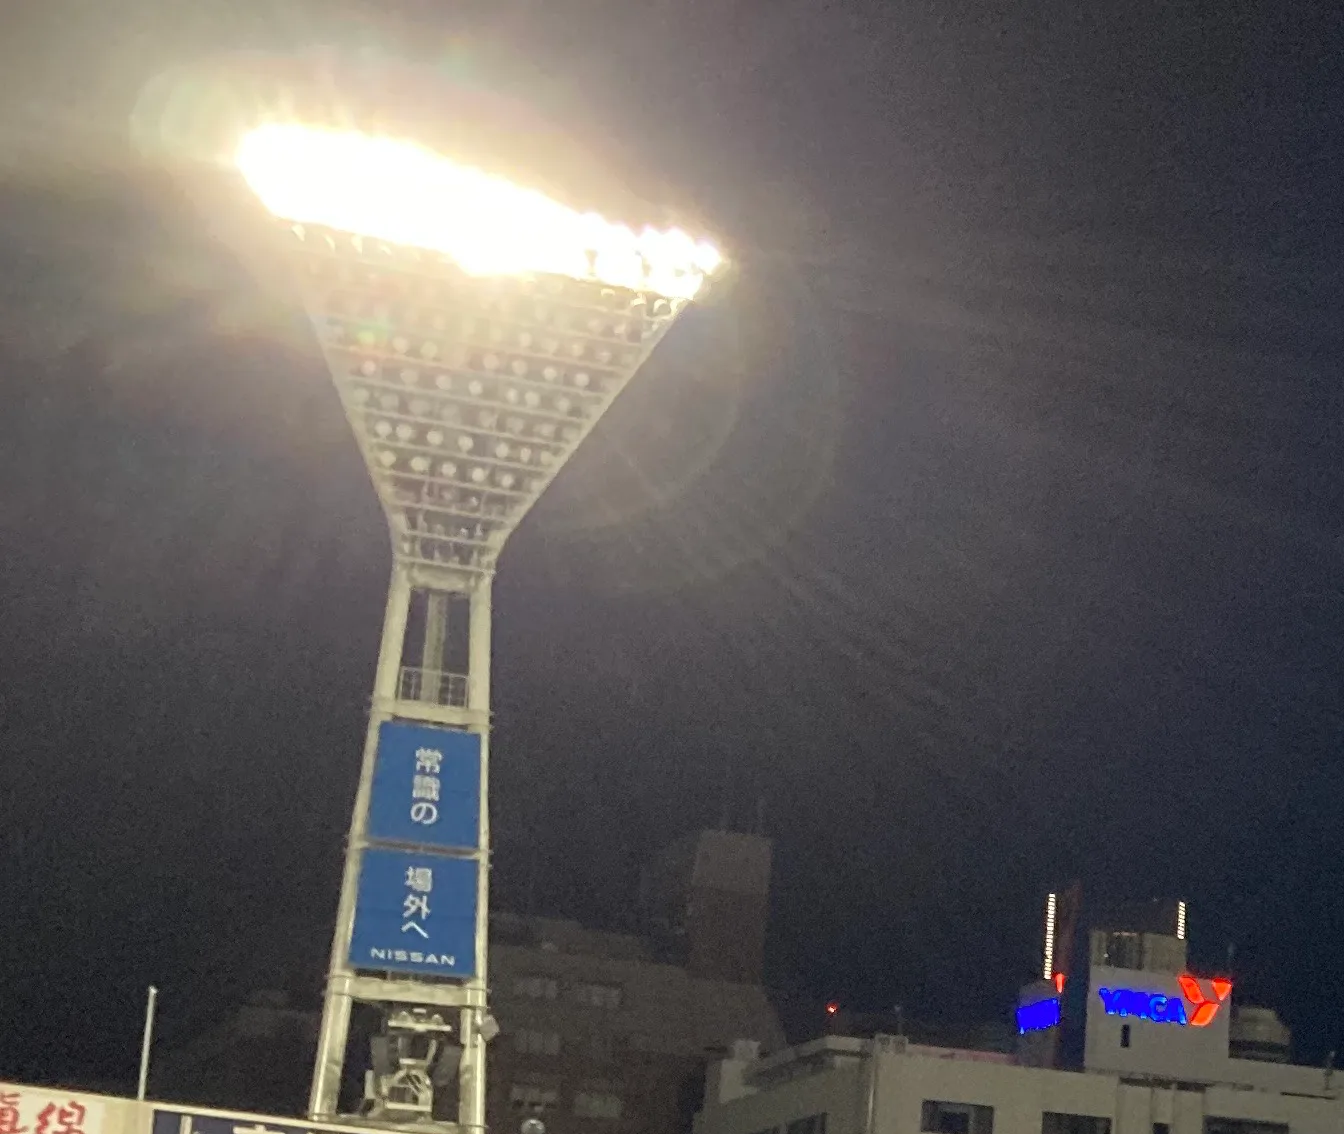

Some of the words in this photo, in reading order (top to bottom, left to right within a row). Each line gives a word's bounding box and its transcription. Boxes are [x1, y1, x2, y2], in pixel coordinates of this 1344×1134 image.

[401, 866, 434, 938] 場外へ
[370, 947, 456, 967] NISSAN
